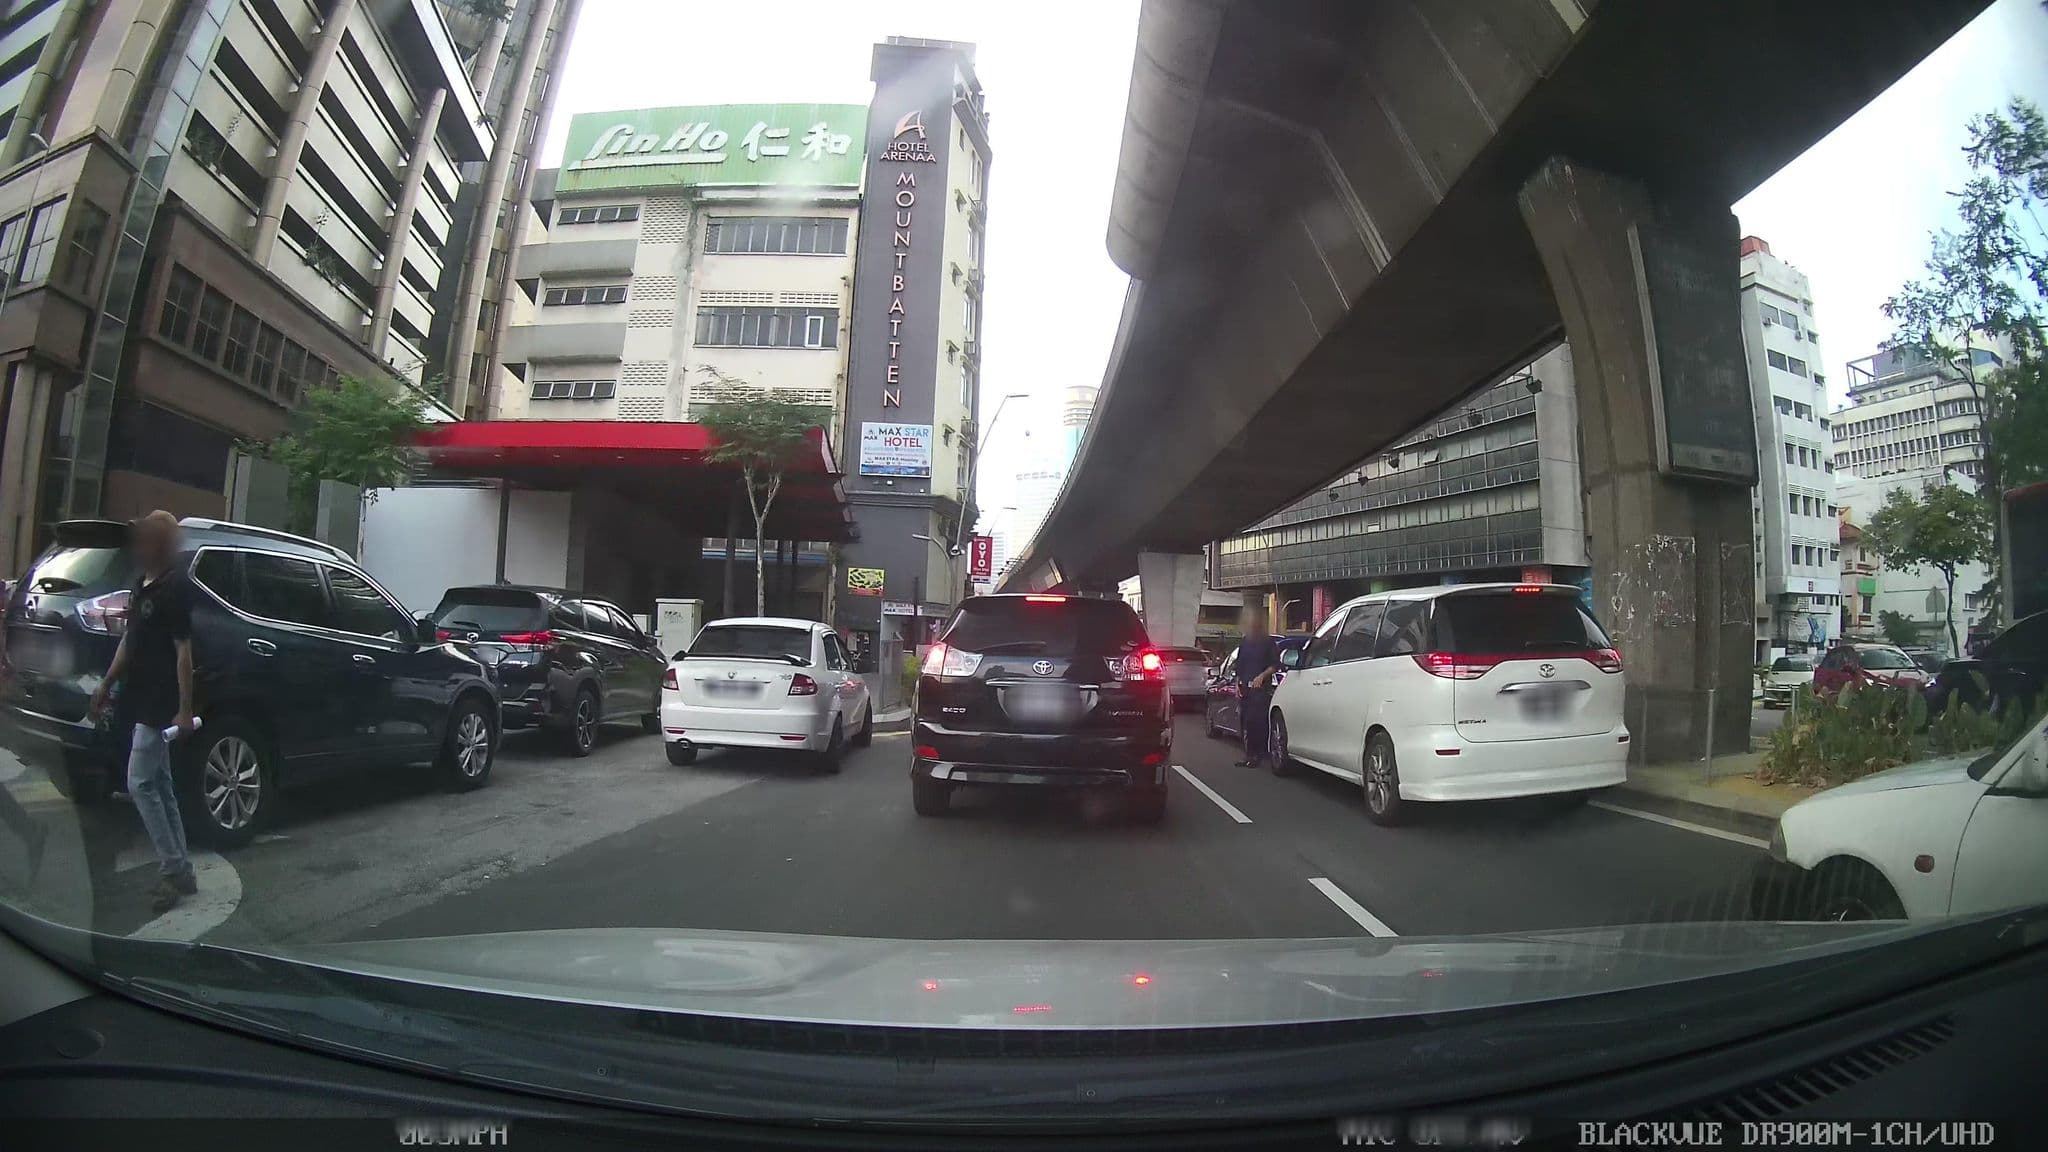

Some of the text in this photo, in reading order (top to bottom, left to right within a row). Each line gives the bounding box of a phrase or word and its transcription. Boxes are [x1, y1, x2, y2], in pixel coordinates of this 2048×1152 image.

[661, 122, 728, 152] Ho
[741, 119, 852, 163] 仁和
[888, 141, 930, 153] HOTEL
[879, 151, 937, 163] ARENAA
[883, 170, 917, 408] MOUNTBATTEN
[879, 426, 929, 438] MAX STAR
[885, 437, 923, 448] HOTEL
[977, 542, 987, 568] OYO
